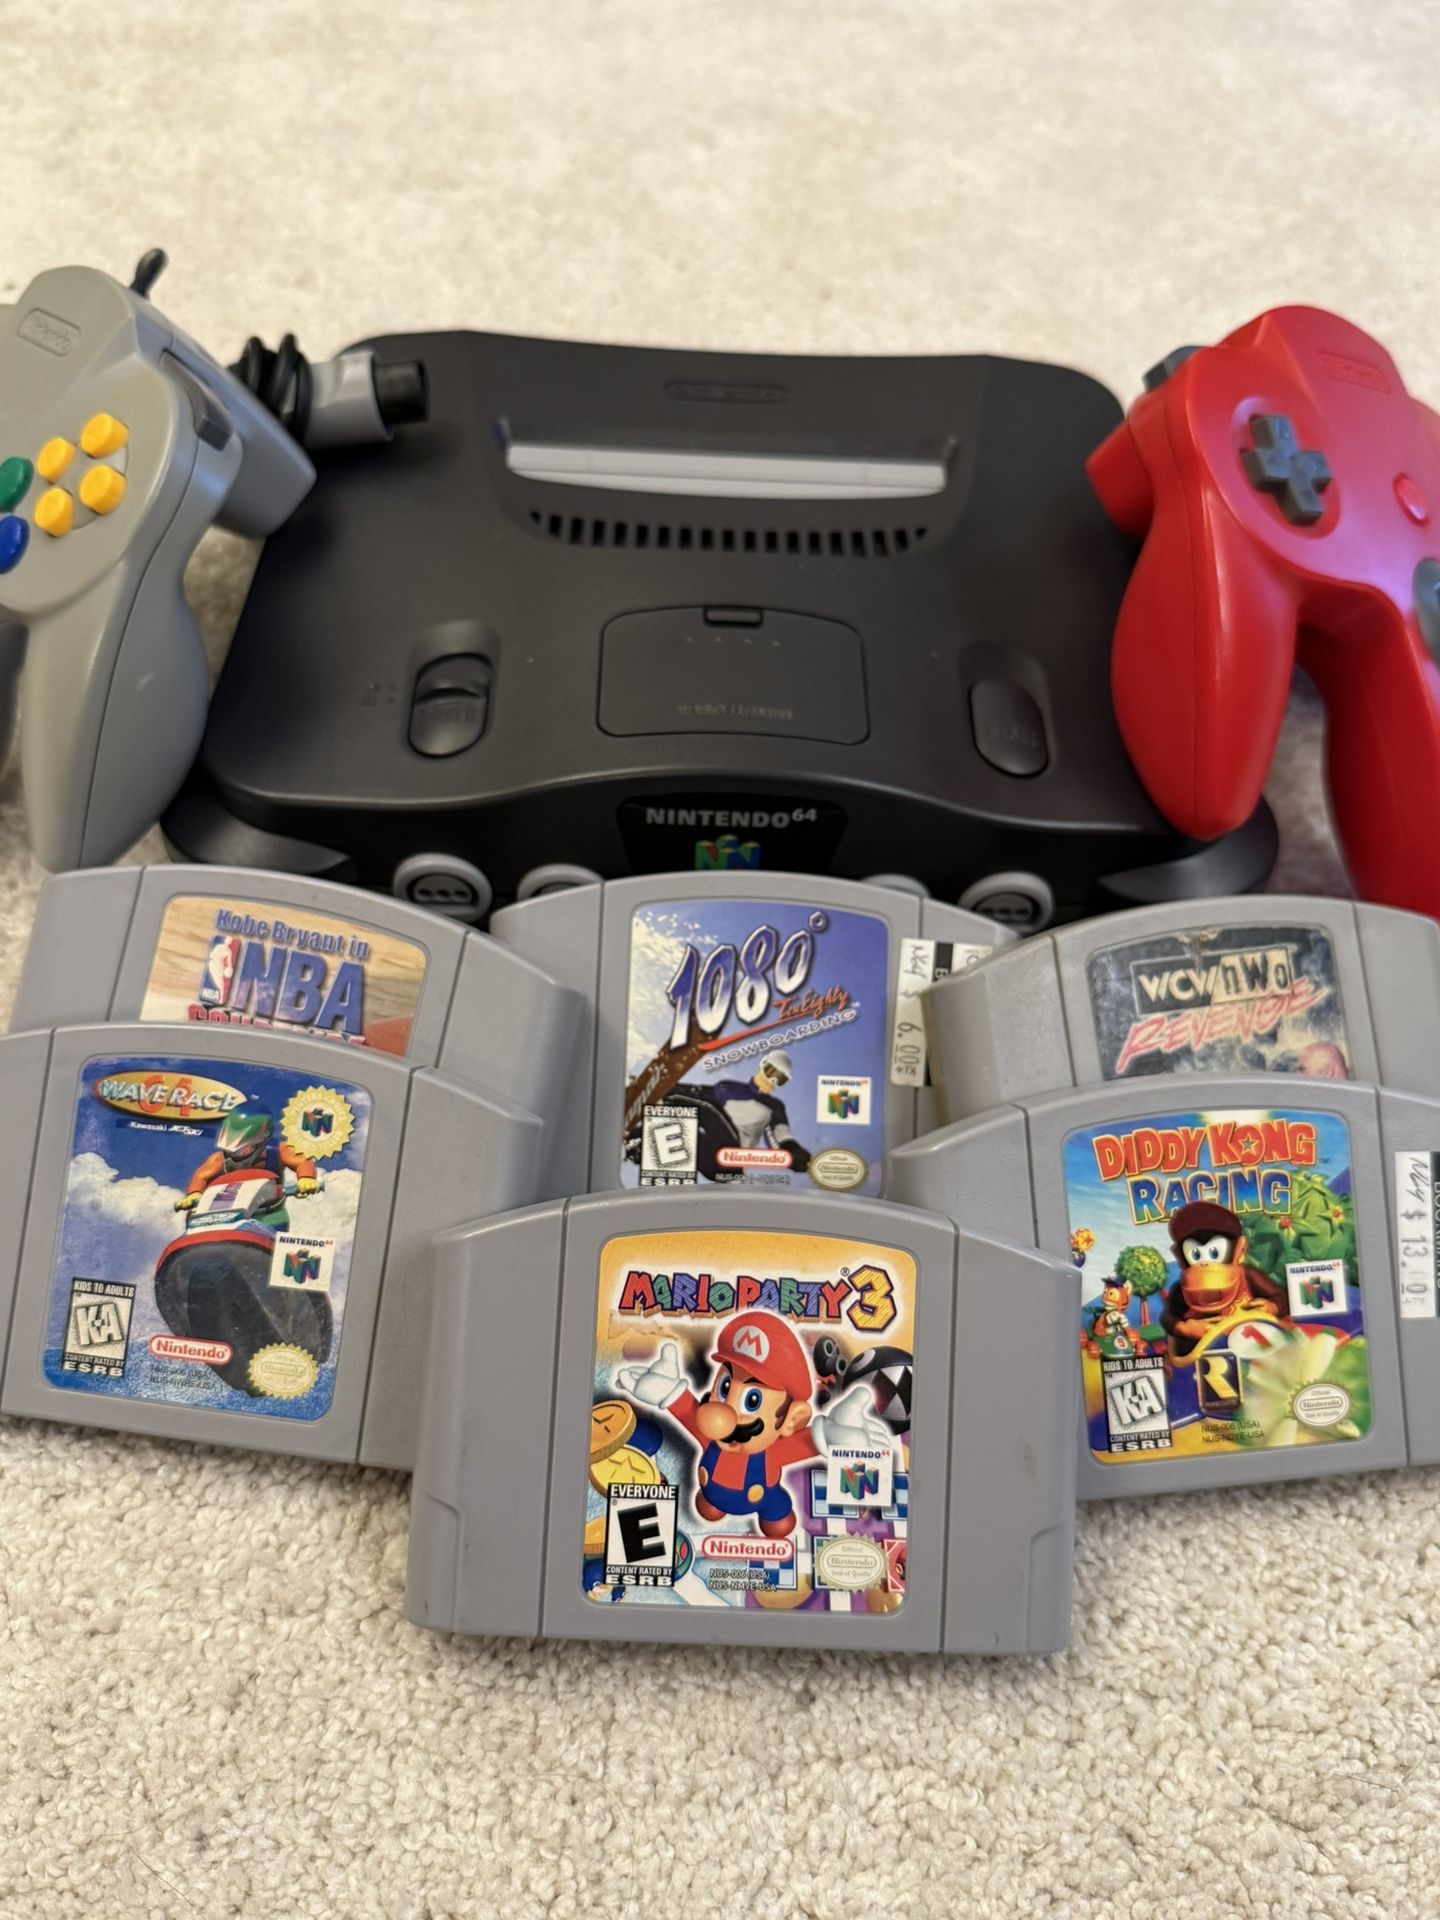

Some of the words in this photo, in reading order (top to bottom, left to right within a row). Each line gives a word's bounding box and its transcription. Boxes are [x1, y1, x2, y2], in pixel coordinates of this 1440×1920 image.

[645, 808, 790, 828] NINTENDO
[215, 909, 269, 936] Kobe
[271, 920, 344, 951] Bryant
[348, 935, 369, 960] in
[231, 941, 366, 1035] NBA
[1138, 965, 1214, 1002] WCW
[202, 988, 219, 1001] NBA
[1115, 975, 1330, 1074] REVENGE
[702, 1007, 858, 1070] SNOWBOARDING
[820, 1078, 861, 1087] NINTENDO
[99, 1080, 166, 1104] WAVE
[168, 1085, 240, 1111] RACE
[644, 1105, 699, 1117] EVERYONE
[129, 1120, 167, 1132] Kawasaki
[654, 1123, 688, 1165] E
[1092, 1126, 1206, 1182] DIDDY
[1210, 1120, 1318, 1168] KONG
[724, 1151, 786, 1164] Nintendo
[1126, 1167, 1294, 1226] RACING
[280, 1235, 325, 1247] NINTENDO
[1289, 1264, 1333, 1275] NINTENDO
[73, 1280, 92, 1292] KIDS
[94, 1283, 104, 1294] TO
[105, 1284, 135, 1298] ADULTS
[619, 1270, 735, 1313] MARIO
[735, 1274, 851, 1319] PARTY
[846, 1265, 897, 1331] 3
[156, 1339, 227, 1360] Nintendo
[734, 1331, 762, 1357] M
[65, 1353, 93, 1363] CONTENT
[94, 1357, 115, 1366] RATED
[116, 1359, 125, 1367] BY
[1103, 1361, 1121, 1372] KIDS
[1123, 1359, 1133, 1370] TO
[1135, 1357, 1163, 1369] ADULTS
[63, 1361, 124, 1377] ESRB
[1303, 1400, 1340, 1409] Nintendo
[1110, 1433, 1139, 1443] CONTENT
[1139, 1431, 1160, 1441] RATED
[1161, 1430, 1170, 1438] BY
[1111, 1438, 1171, 1453] ESRB
[832, 1449, 880, 1460] NINTENDO
[610, 1484, 676, 1499] EVERYONE
[617, 1502, 667, 1564] E
[709, 1540, 788, 1556] Nintendo
[831, 1557, 874, 1566] Nintendo
[606, 1566, 639, 1574] CONTENT
[639, 1567, 662, 1575] RATED
[663, 1568, 673, 1576] BY
[709, 1568, 746, 1579] NUS-006
[747, 1569, 770, 1581] (USA)
[605, 1575, 673, 1587] ESRB
